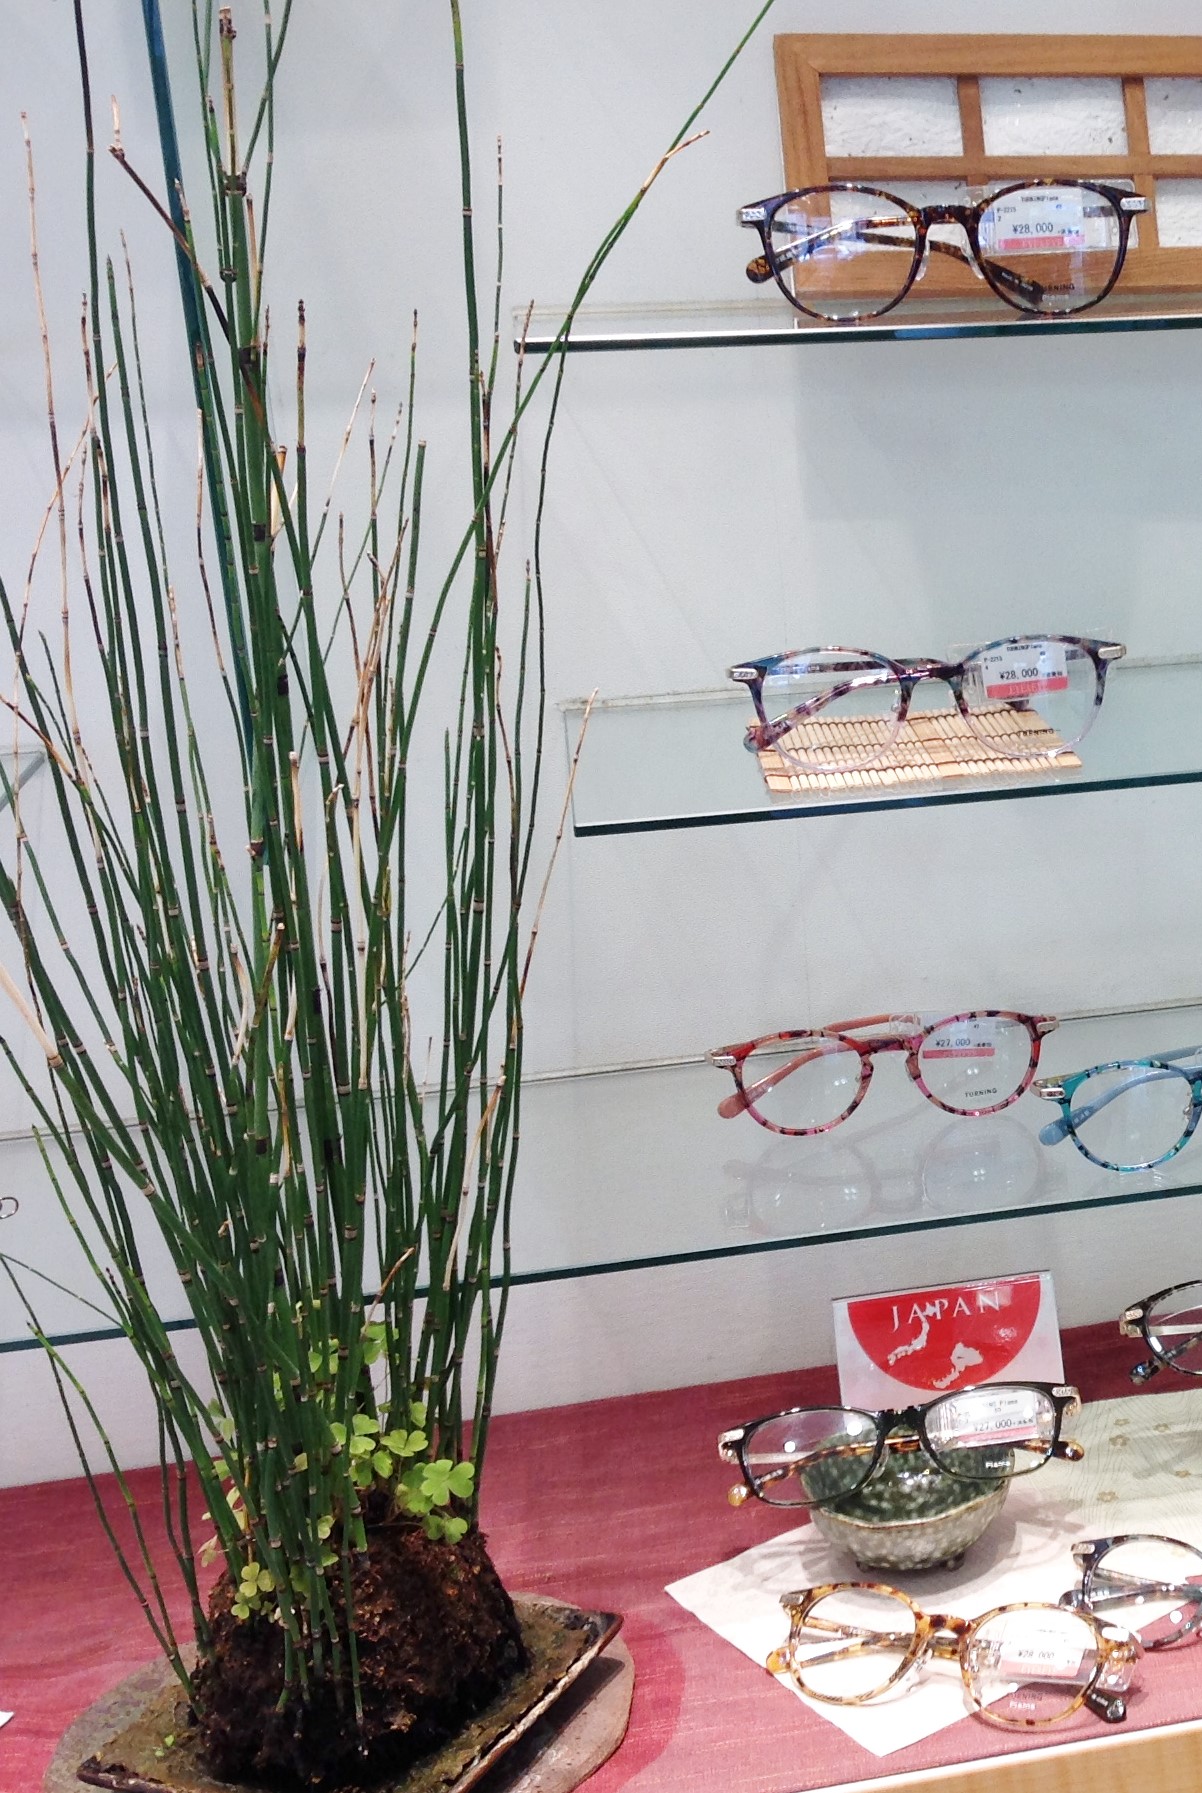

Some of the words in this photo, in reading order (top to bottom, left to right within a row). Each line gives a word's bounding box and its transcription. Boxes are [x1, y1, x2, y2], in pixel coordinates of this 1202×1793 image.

[1012, 222, 1054, 235] ¥28,000
[999, 667, 1039, 680] ¥28,000
[892, 1291, 1000, 1333] JAPAN
